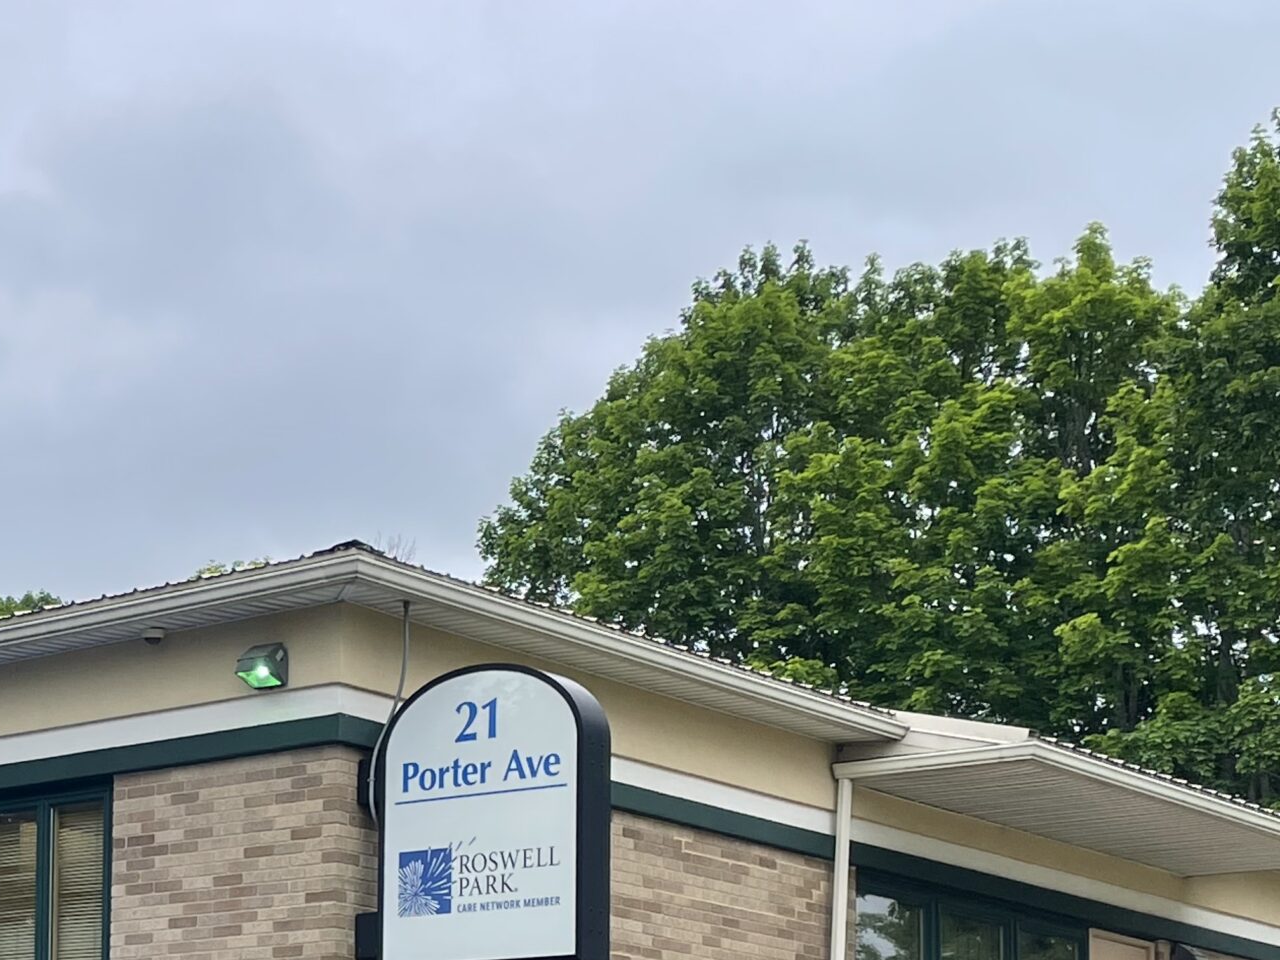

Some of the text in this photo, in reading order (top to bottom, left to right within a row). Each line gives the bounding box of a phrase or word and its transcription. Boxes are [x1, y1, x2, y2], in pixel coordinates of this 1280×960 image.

[454, 697, 498, 743] 21
[402, 749, 561, 793] Porter Ave
[458, 846, 561, 874] ROSWELL
[457, 896, 561, 913] CARE NETWORK MEMBER
